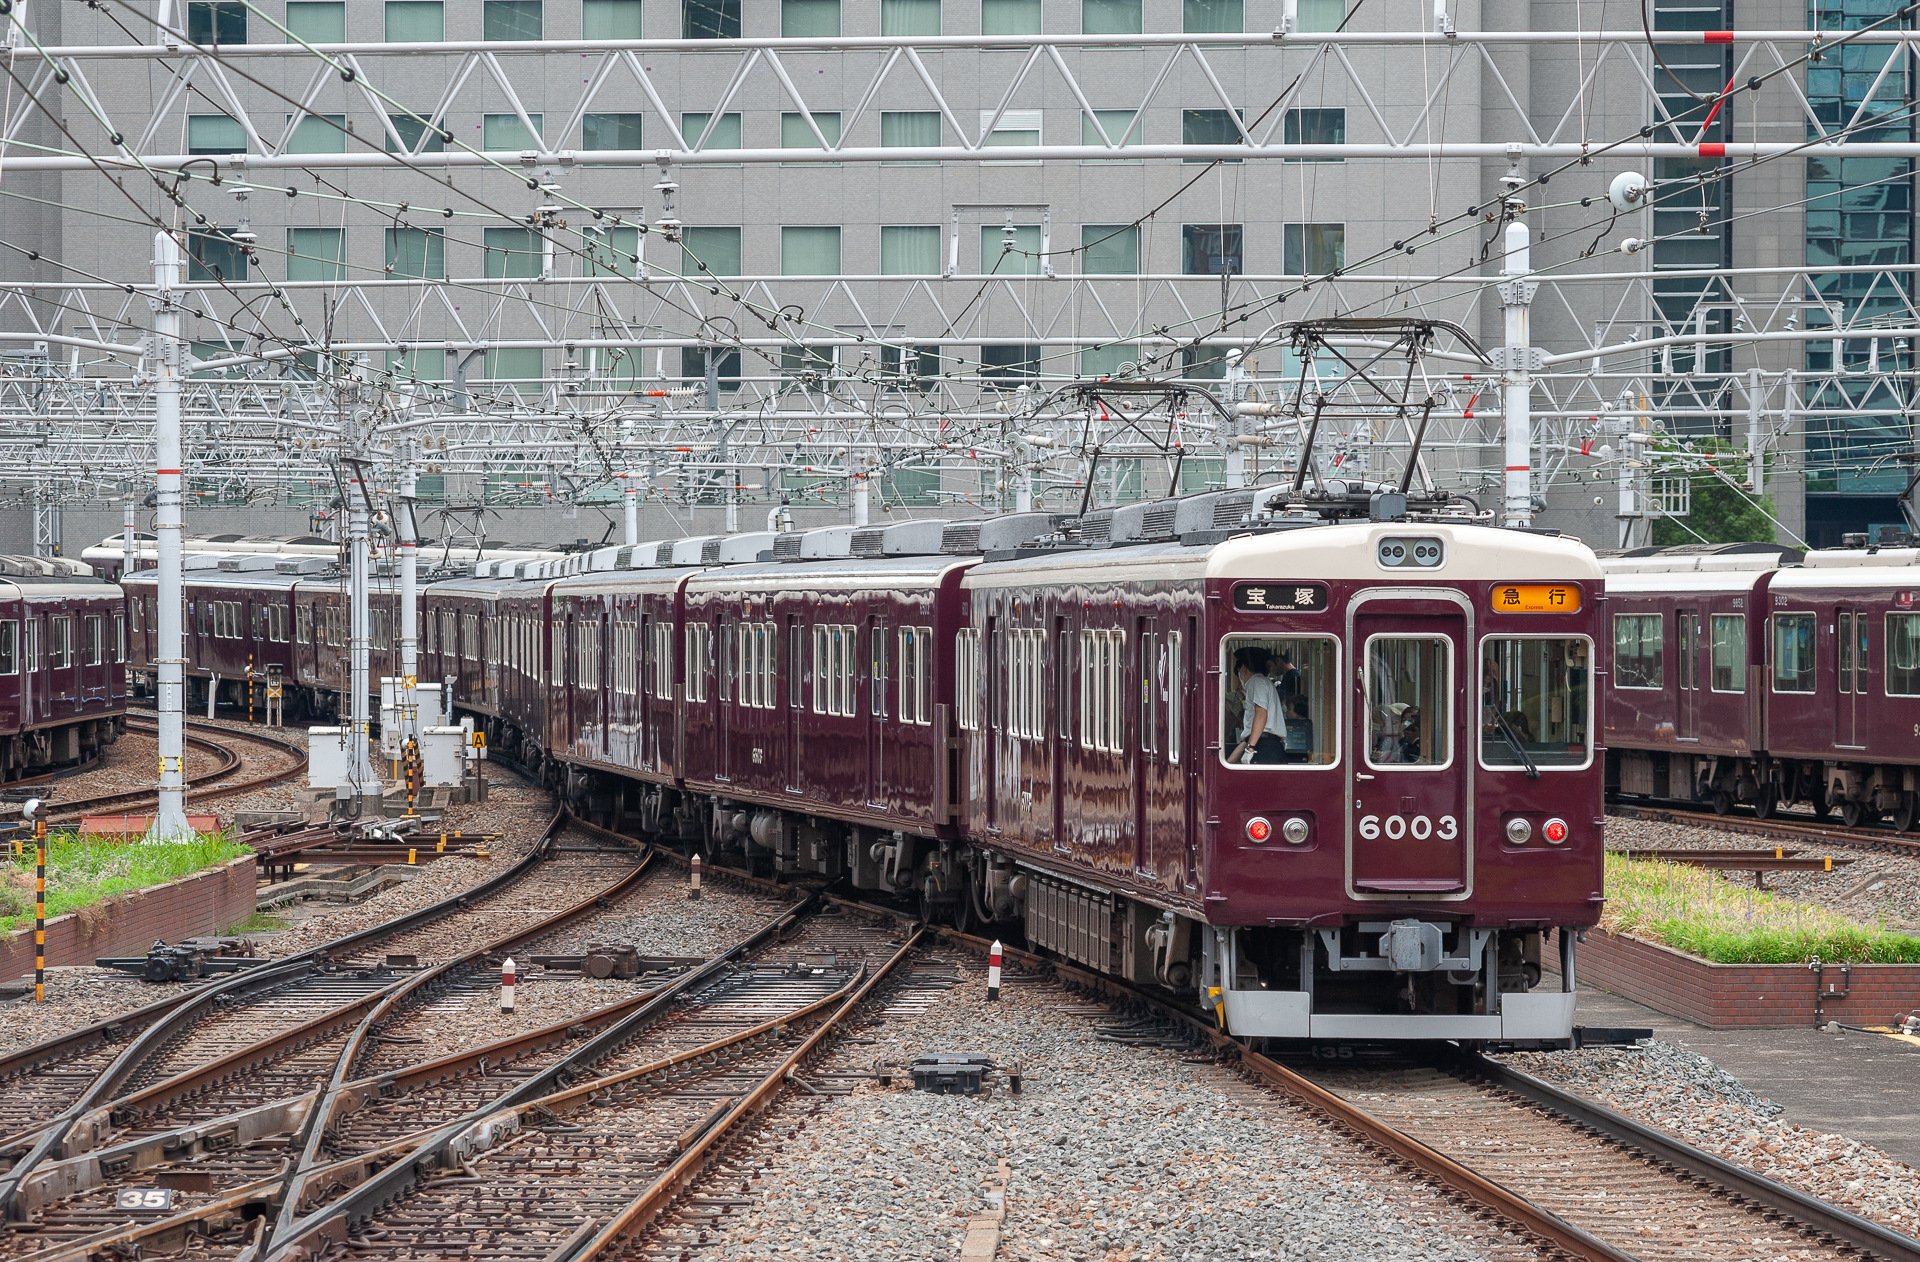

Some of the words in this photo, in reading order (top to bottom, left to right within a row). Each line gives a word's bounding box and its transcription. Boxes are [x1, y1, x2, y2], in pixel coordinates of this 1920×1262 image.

[1247, 588, 1314, 605] 宝塚
[1503, 588, 1566, 605] 急行
[474, 734, 483, 747] A
[1359, 815, 1458, 840] 6003
[121, 1191, 166, 1208] 35
